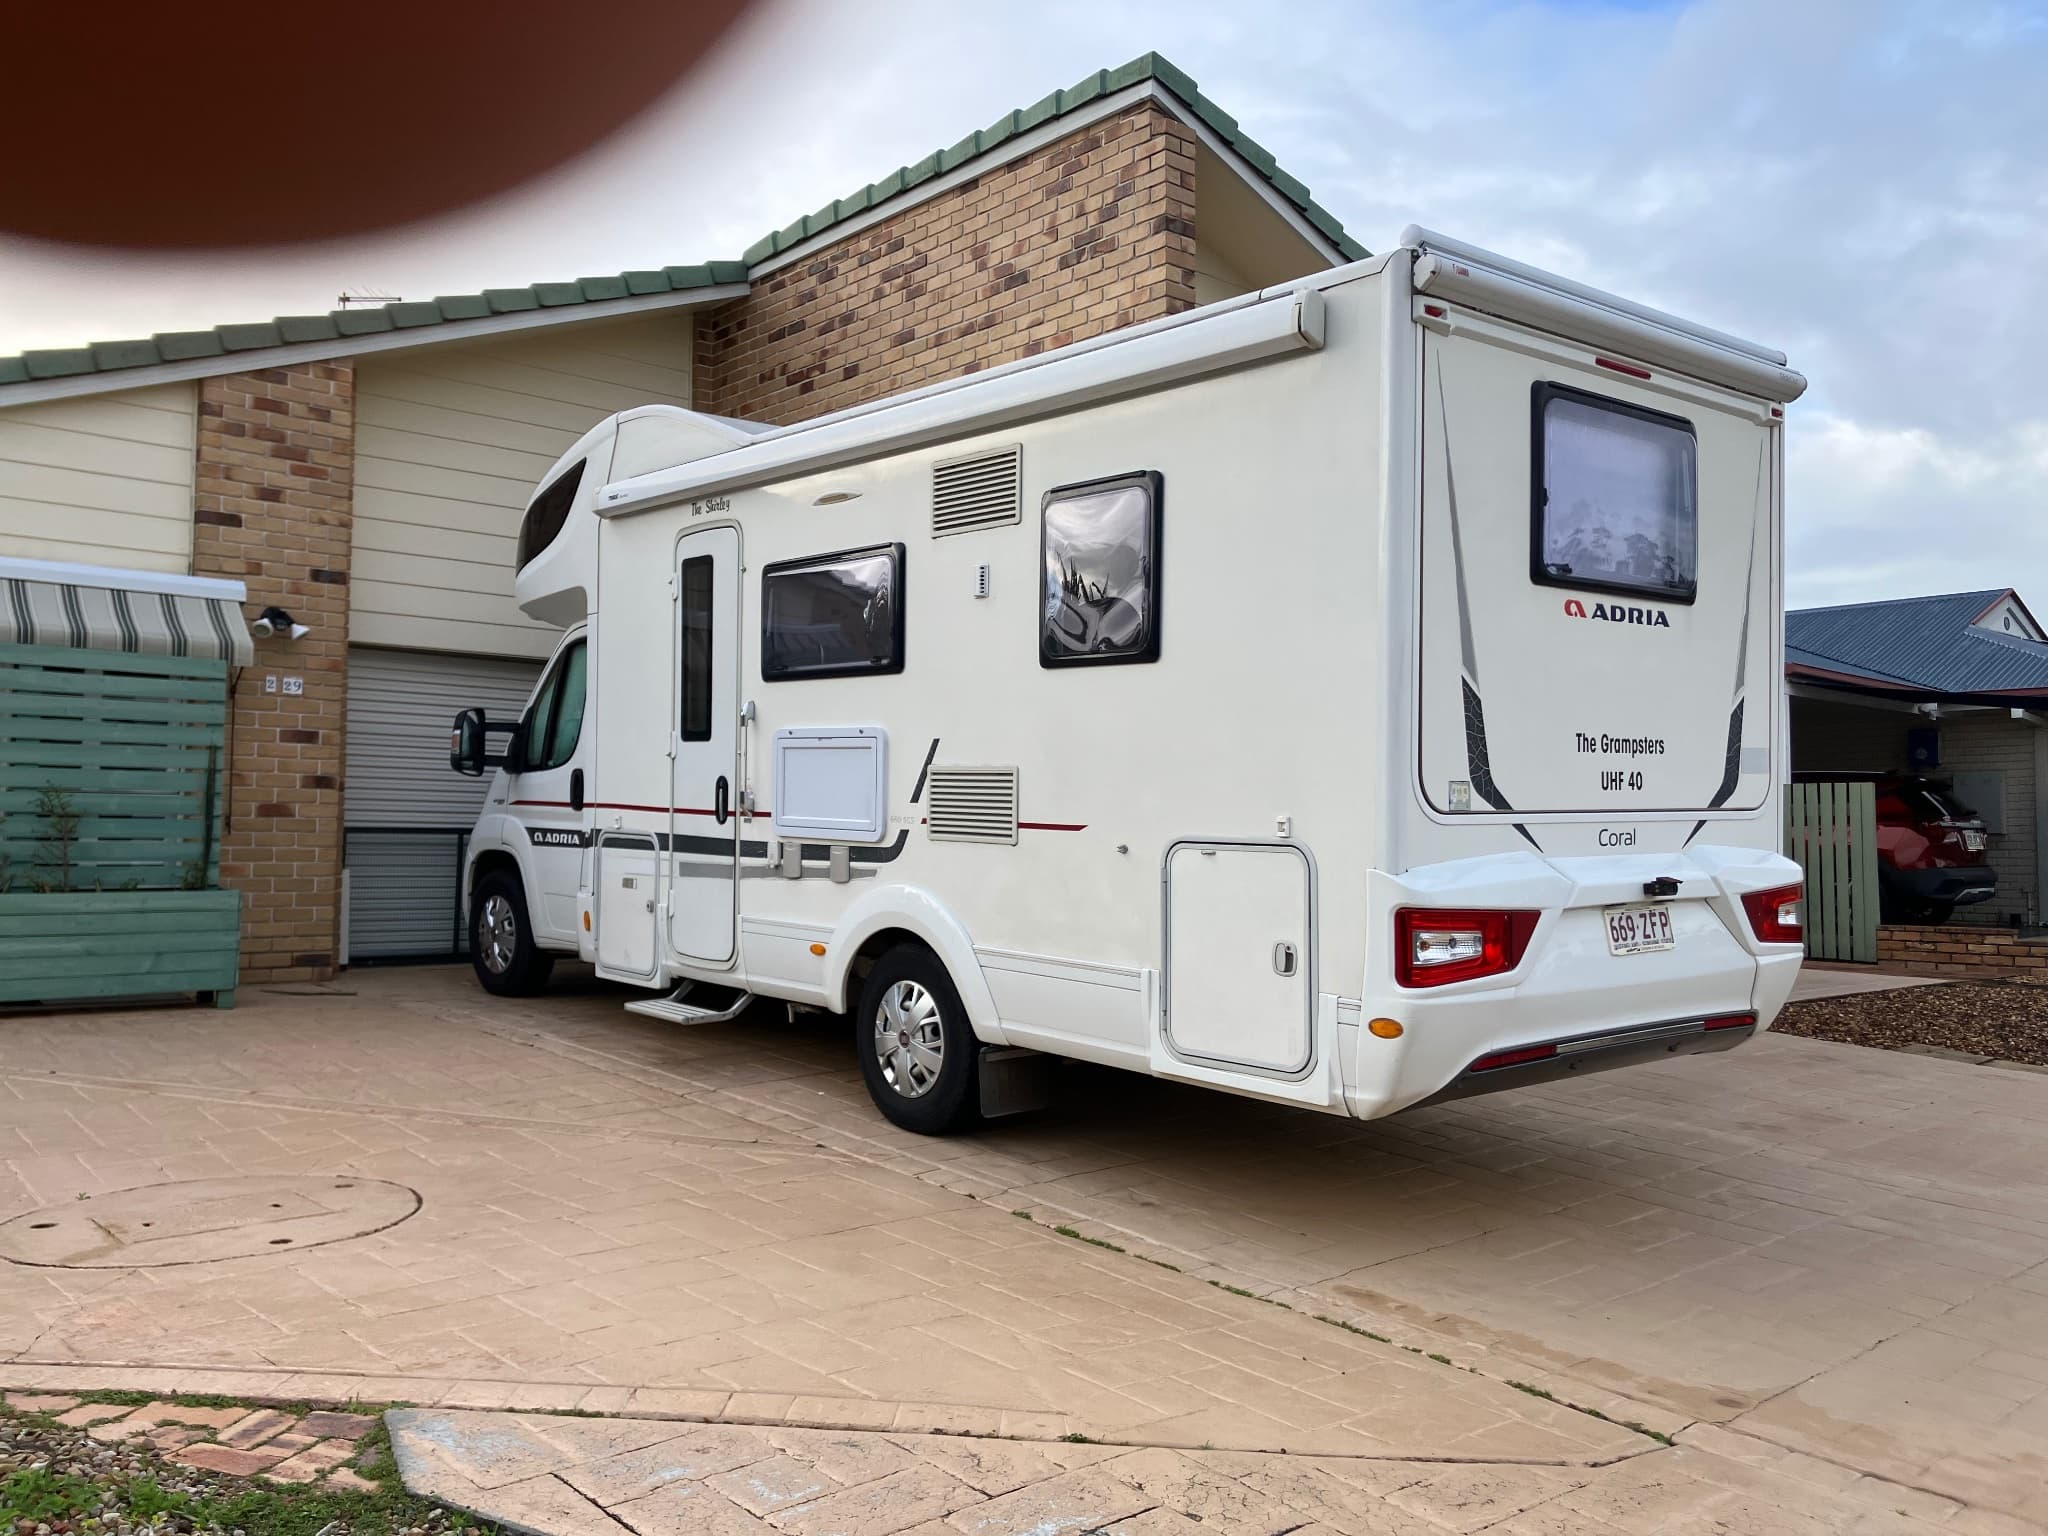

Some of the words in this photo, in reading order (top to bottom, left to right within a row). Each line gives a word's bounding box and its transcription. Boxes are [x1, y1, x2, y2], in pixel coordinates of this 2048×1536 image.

[691, 502, 702, 516] The
[1591, 603, 1670, 627] ADRIA
[284, 680, 301, 692] 29
[1576, 733, 1597, 753] The
[1601, 734, 1665, 758] Grampsters
[1601, 771, 1624, 790] UHF
[1628, 771, 1643, 790] 40
[545, 833, 579, 845] ADRIA
[1598, 828, 1636, 846] Coral
